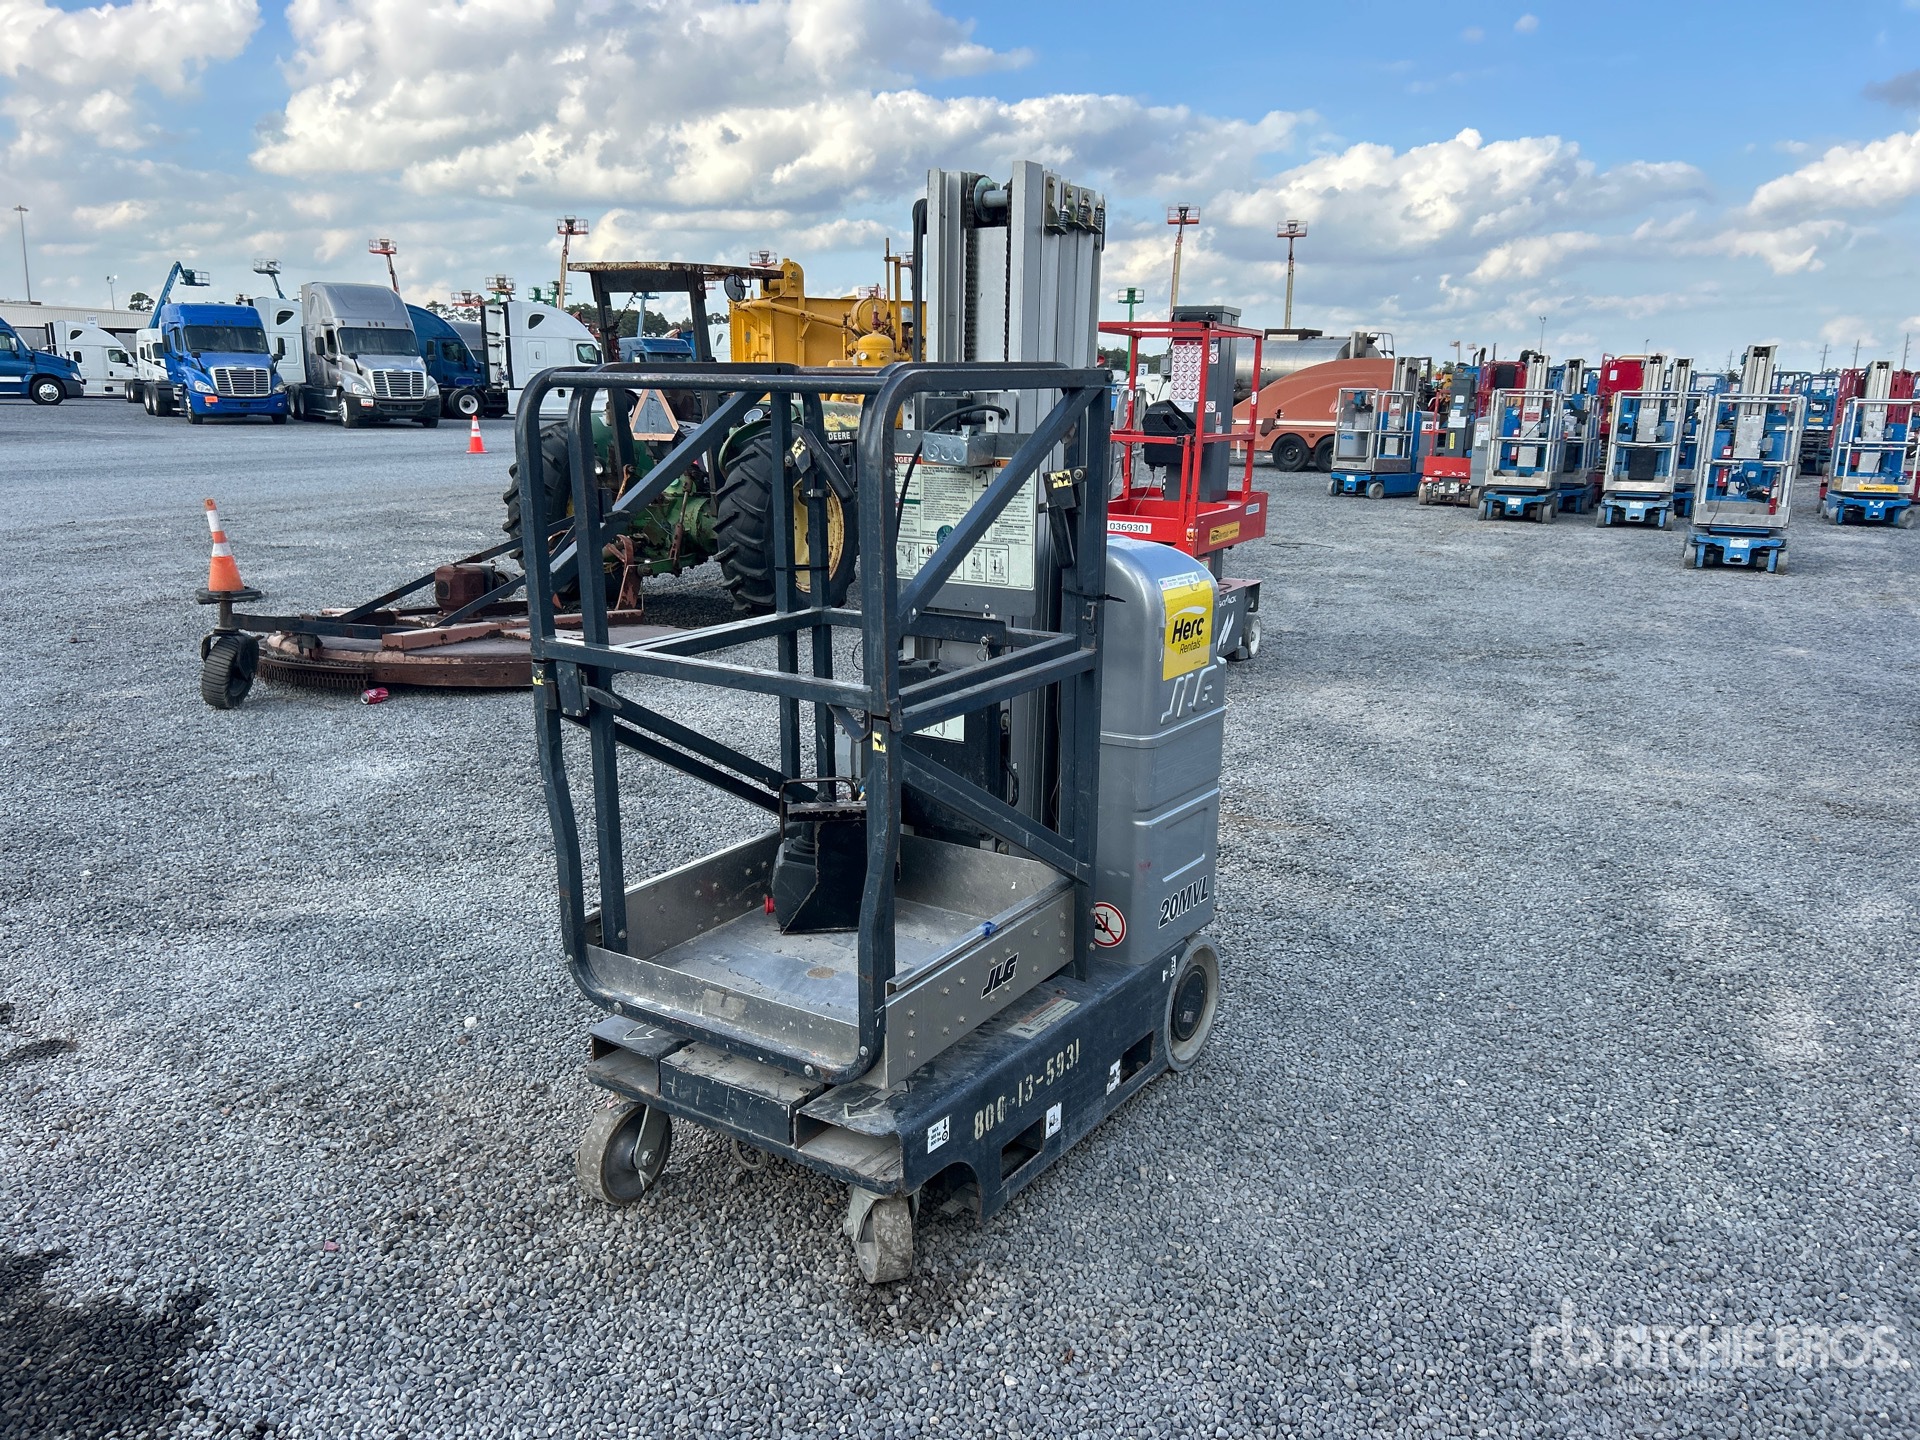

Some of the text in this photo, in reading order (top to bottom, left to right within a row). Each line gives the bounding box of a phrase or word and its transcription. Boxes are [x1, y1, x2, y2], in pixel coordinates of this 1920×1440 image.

[1140, 368, 1146, 376] 3
[828, 431, 851, 441] DEERE
[894, 456, 914, 464] NGER
[1109, 522, 1150, 533] 0369301
[1171, 617, 1205, 645] Herc
[1158, 874, 1209, 929] 20MVL
[980, 951, 1019, 1000] JLG
